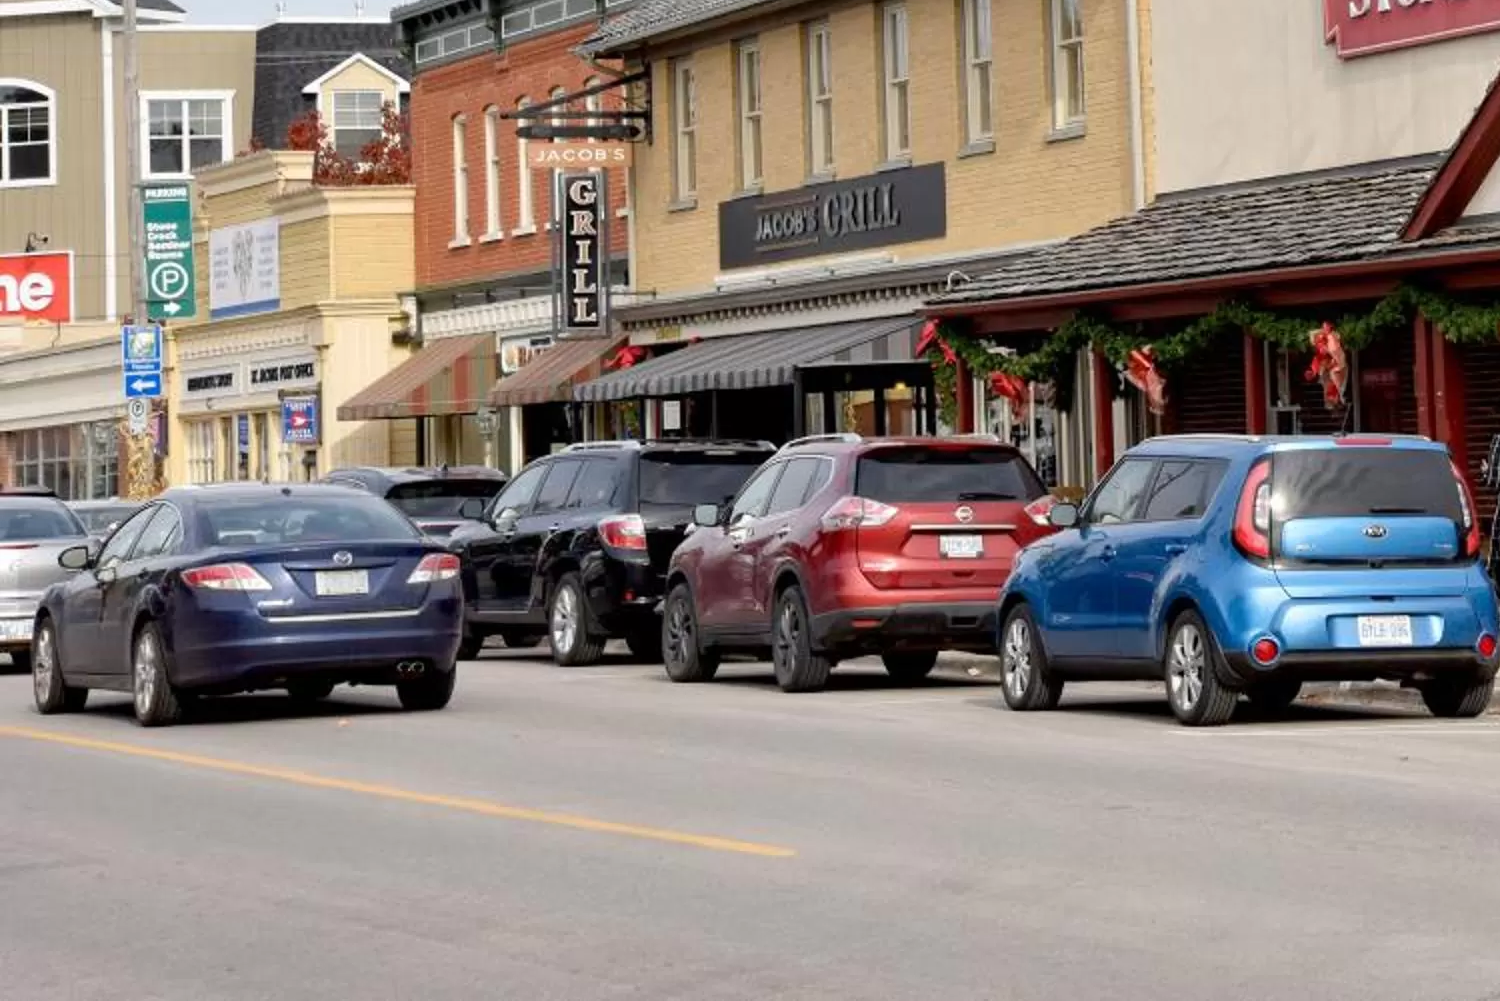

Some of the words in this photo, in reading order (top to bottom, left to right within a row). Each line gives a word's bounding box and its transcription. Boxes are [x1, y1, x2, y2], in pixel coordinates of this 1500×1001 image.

[535, 147, 625, 163] JACOB'S
[755, 205, 819, 241] JACOB'S
[823, 182, 901, 238] GRILL
[569, 179, 598, 324] GRILL
